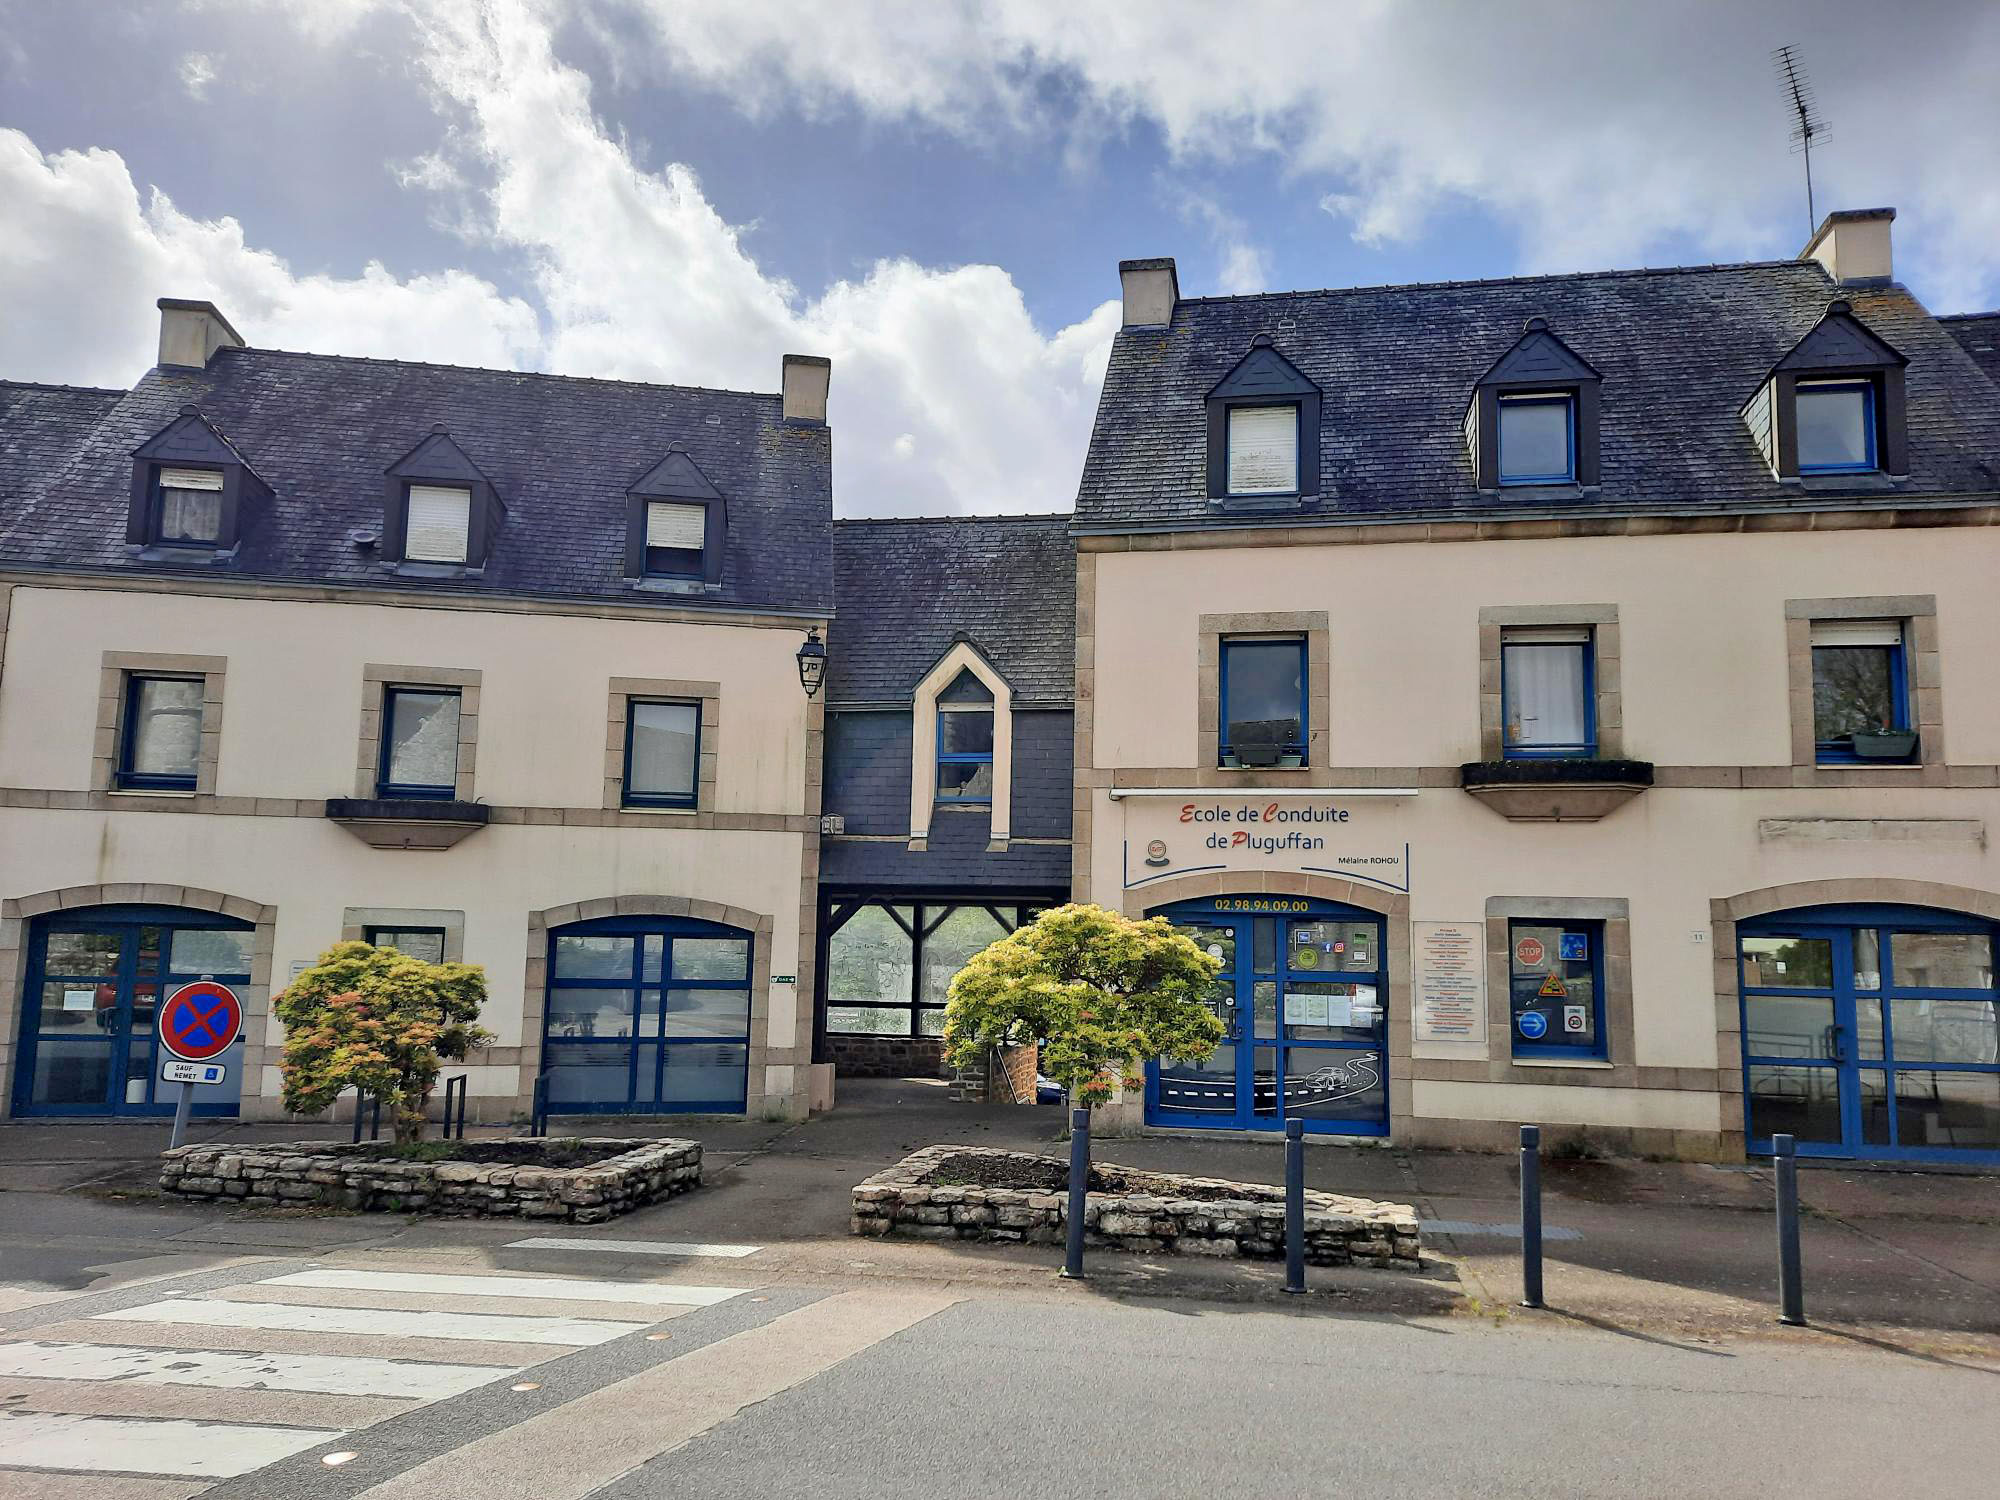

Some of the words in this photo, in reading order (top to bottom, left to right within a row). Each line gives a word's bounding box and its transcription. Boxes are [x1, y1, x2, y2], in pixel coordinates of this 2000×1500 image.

[1179, 804, 1231, 823] Ecole
[1236, 805, 1259, 822] de
[1262, 802, 1349, 823] Conduite
[1205, 831, 1228, 849] de
[1231, 830, 1324, 855] Pluguffan
[1215, 899, 1309, 912] 02.98.94.09.00
[1518, 947, 1541, 956] STOP
